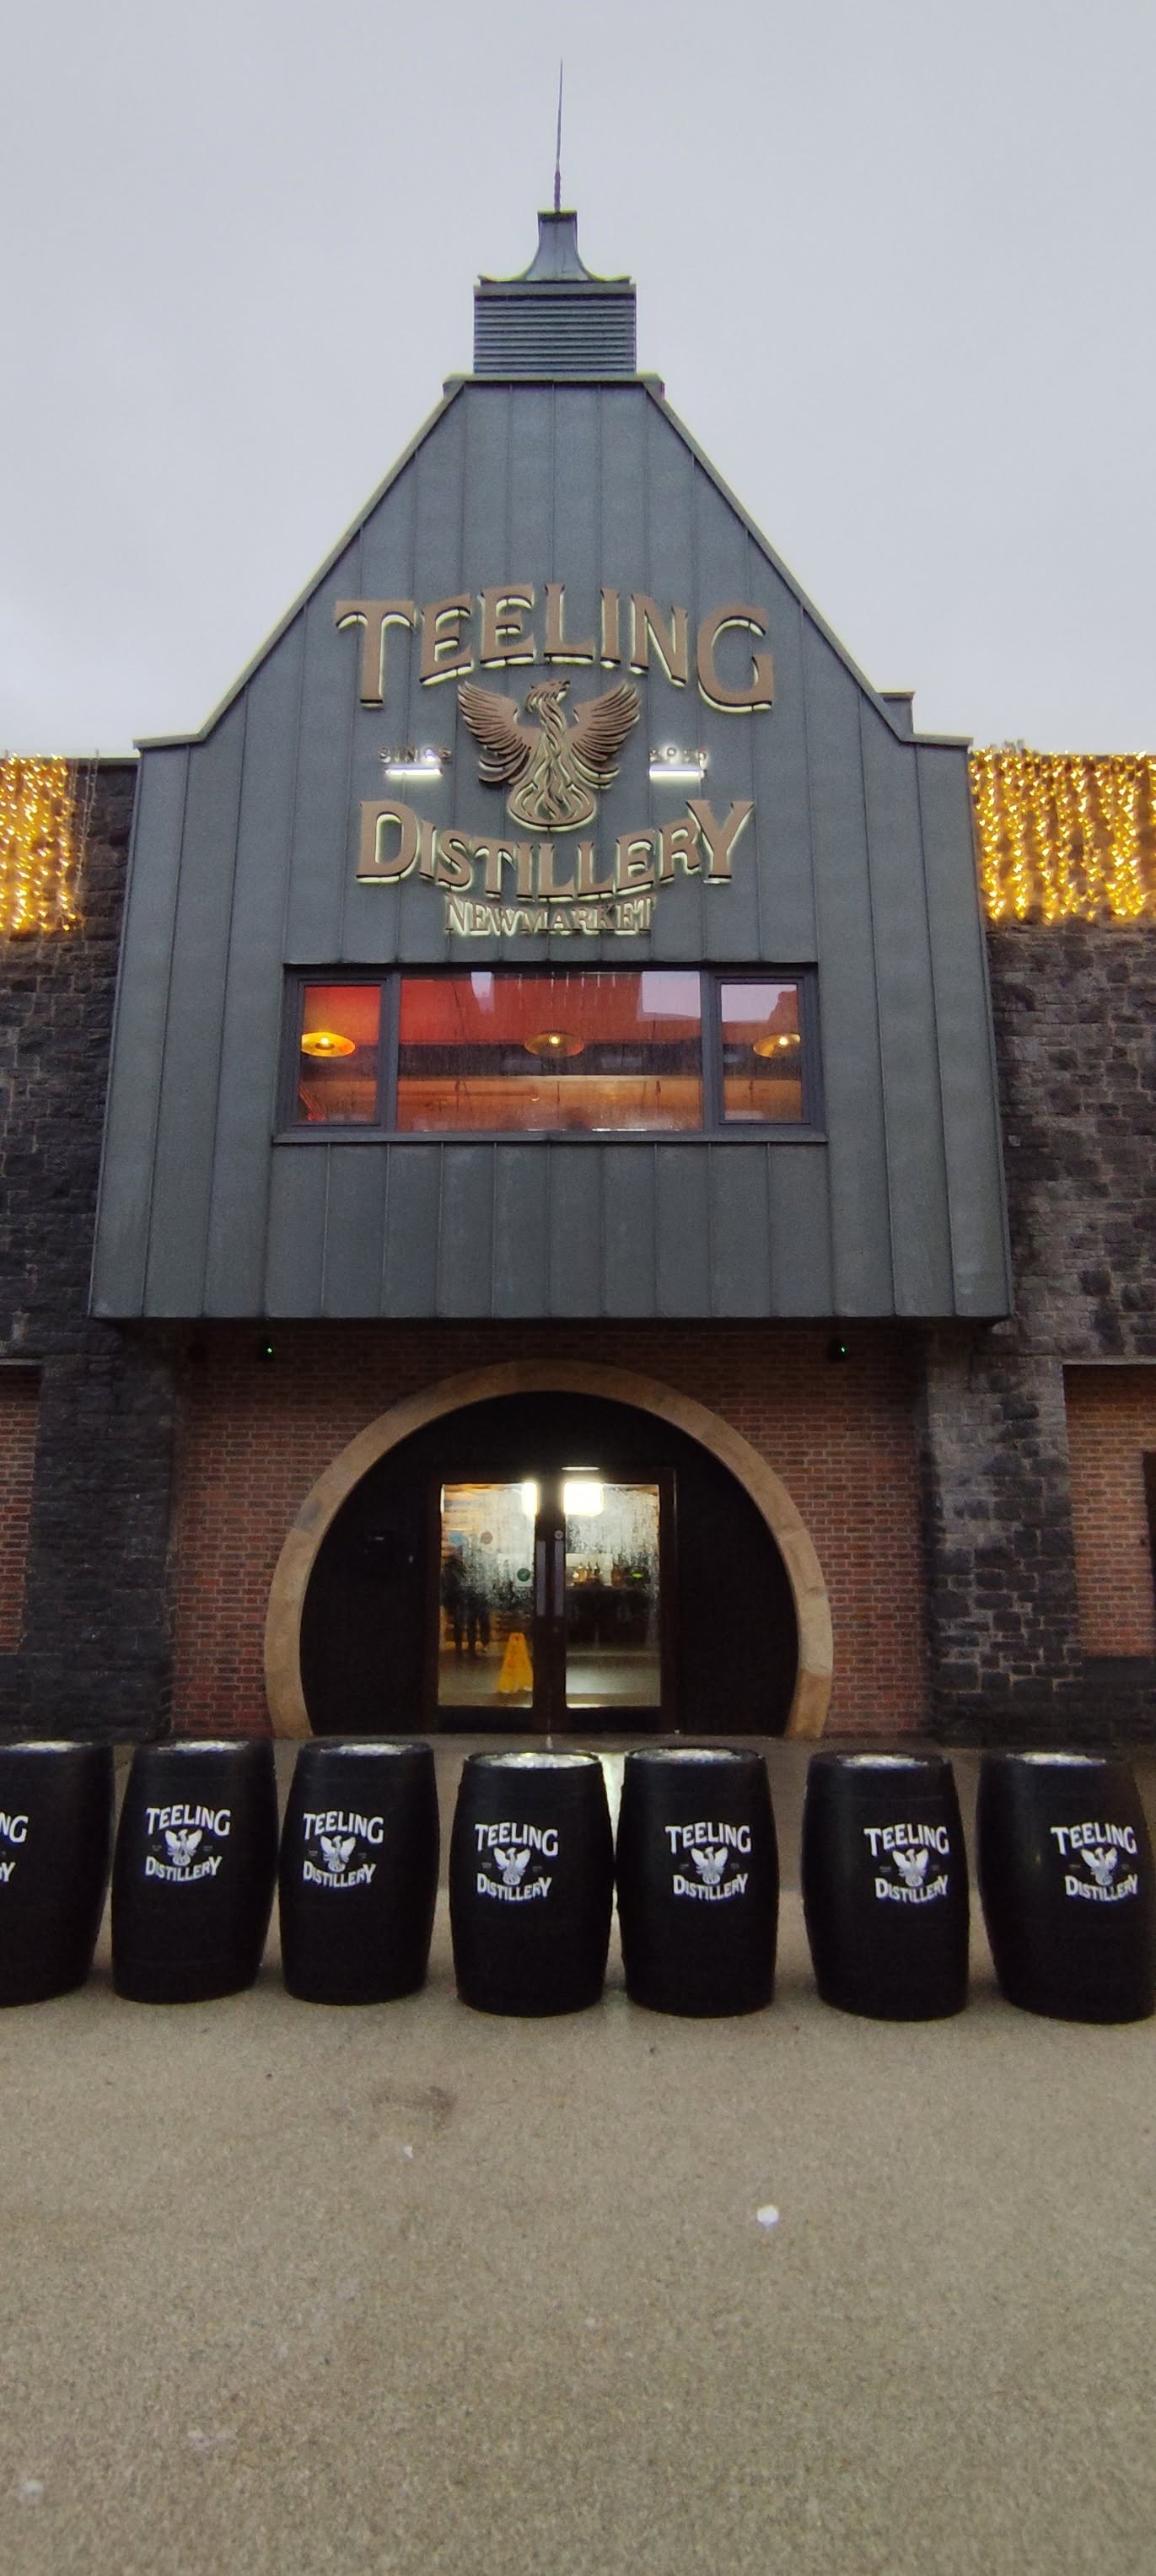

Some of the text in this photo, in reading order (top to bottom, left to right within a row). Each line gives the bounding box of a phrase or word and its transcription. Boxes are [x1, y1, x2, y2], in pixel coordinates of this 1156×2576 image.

[334, 583, 775, 713] TEELING
[379, 744, 452, 763] SIN
[356, 799, 755, 903] DISTILLERY
[444, 891, 657, 936] NEWMARKET
[146, 1804, 231, 1836] TEELING
[304, 1811, 384, 1844] TEELING
[475, 1822, 558, 1857] TEELING
[664, 1821, 751, 1855] TEELING
[863, 1823, 949, 1857] TEELING
[1051, 1821, 1137, 1856] TEELING
[145, 1856, 223, 1882] DISTILLERY
[304, 1860, 376, 1888] DISTILLERY
[477, 1873, 552, 1901] DISTILLERY
[673, 1873, 749, 1901] DISTILLERY
[874, 1874, 949, 1903] DISTILLERY
[1064, 1874, 1138, 1901] DISTILLERY
